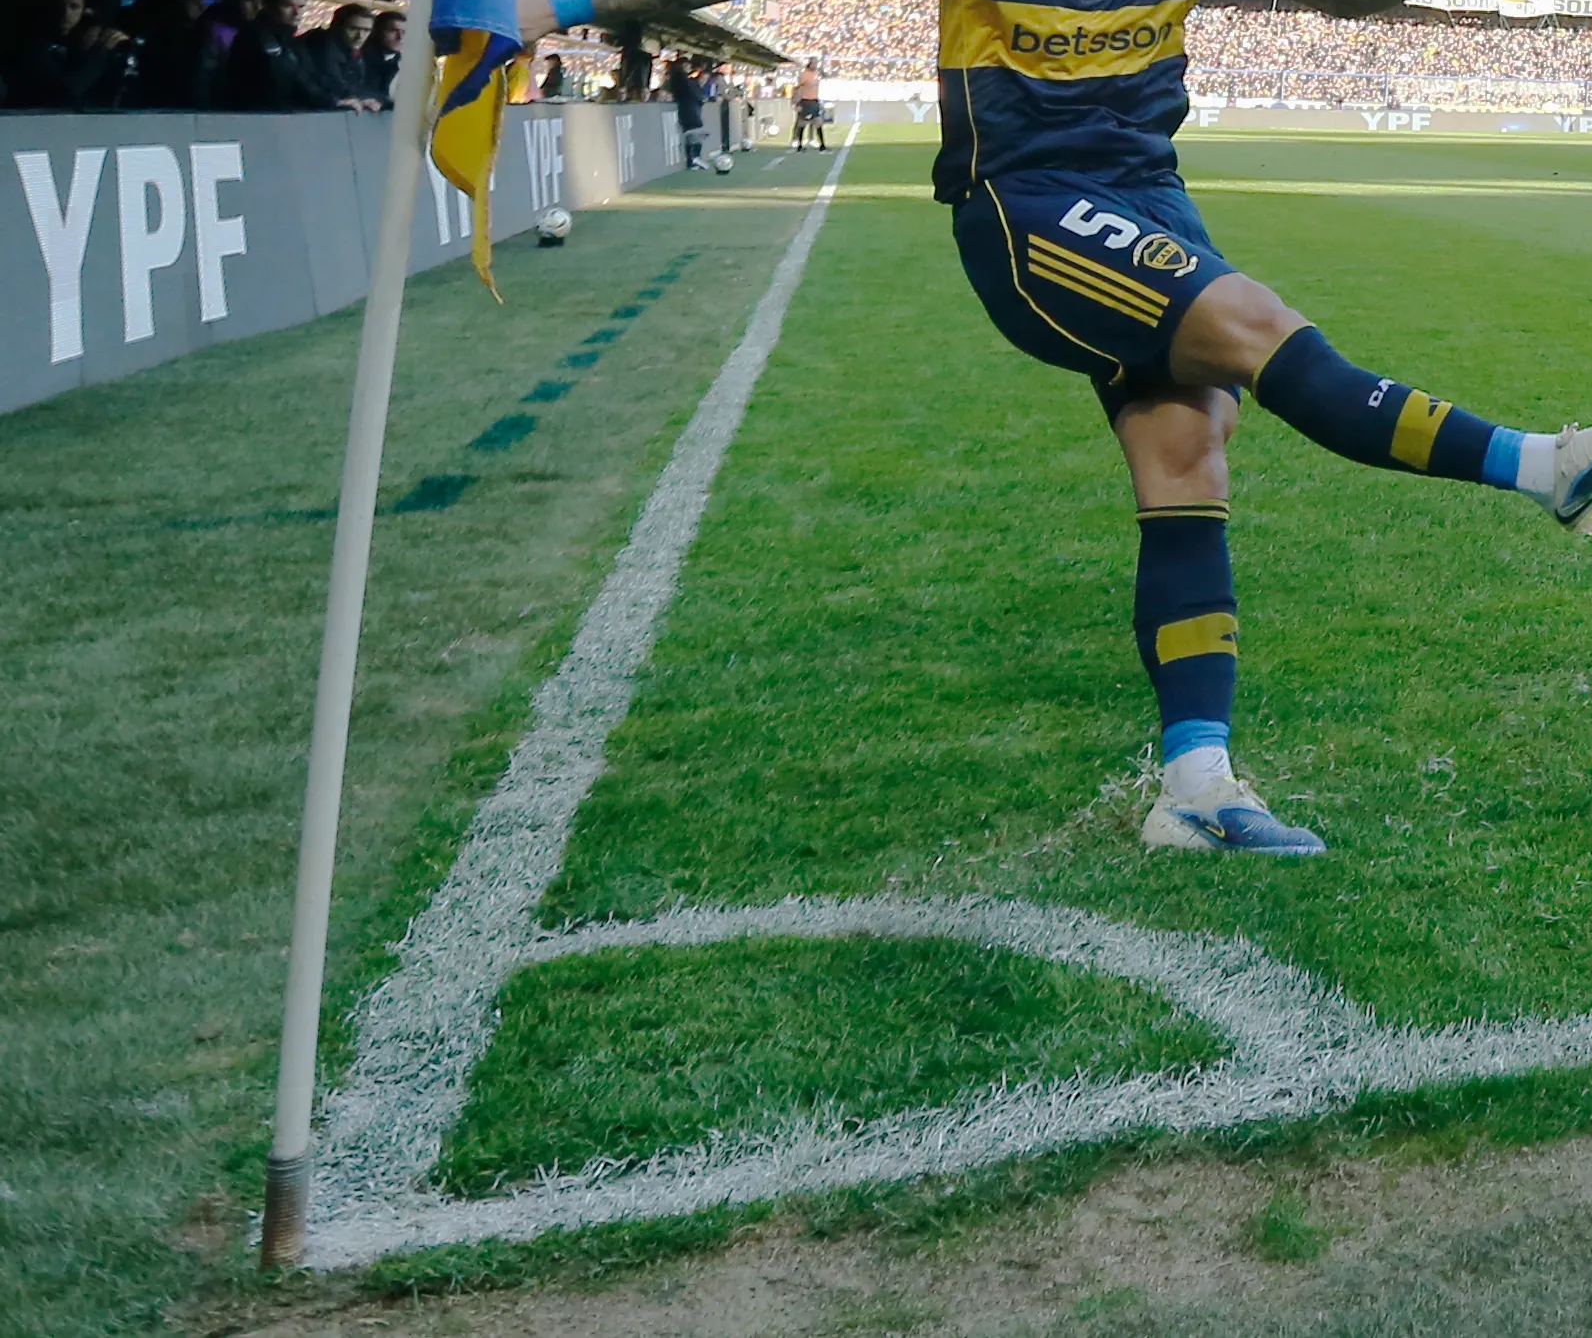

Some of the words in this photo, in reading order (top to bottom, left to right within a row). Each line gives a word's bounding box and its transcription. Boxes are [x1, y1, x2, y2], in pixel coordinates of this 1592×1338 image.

[1010, 21, 1173, 58] betsson
[1183, 108, 1220, 128] PF
[1361, 111, 1432, 131] YPF
[522, 117, 564, 212] YPF
[1058, 198, 1142, 250] 5
[13, 140, 249, 364] YPF
